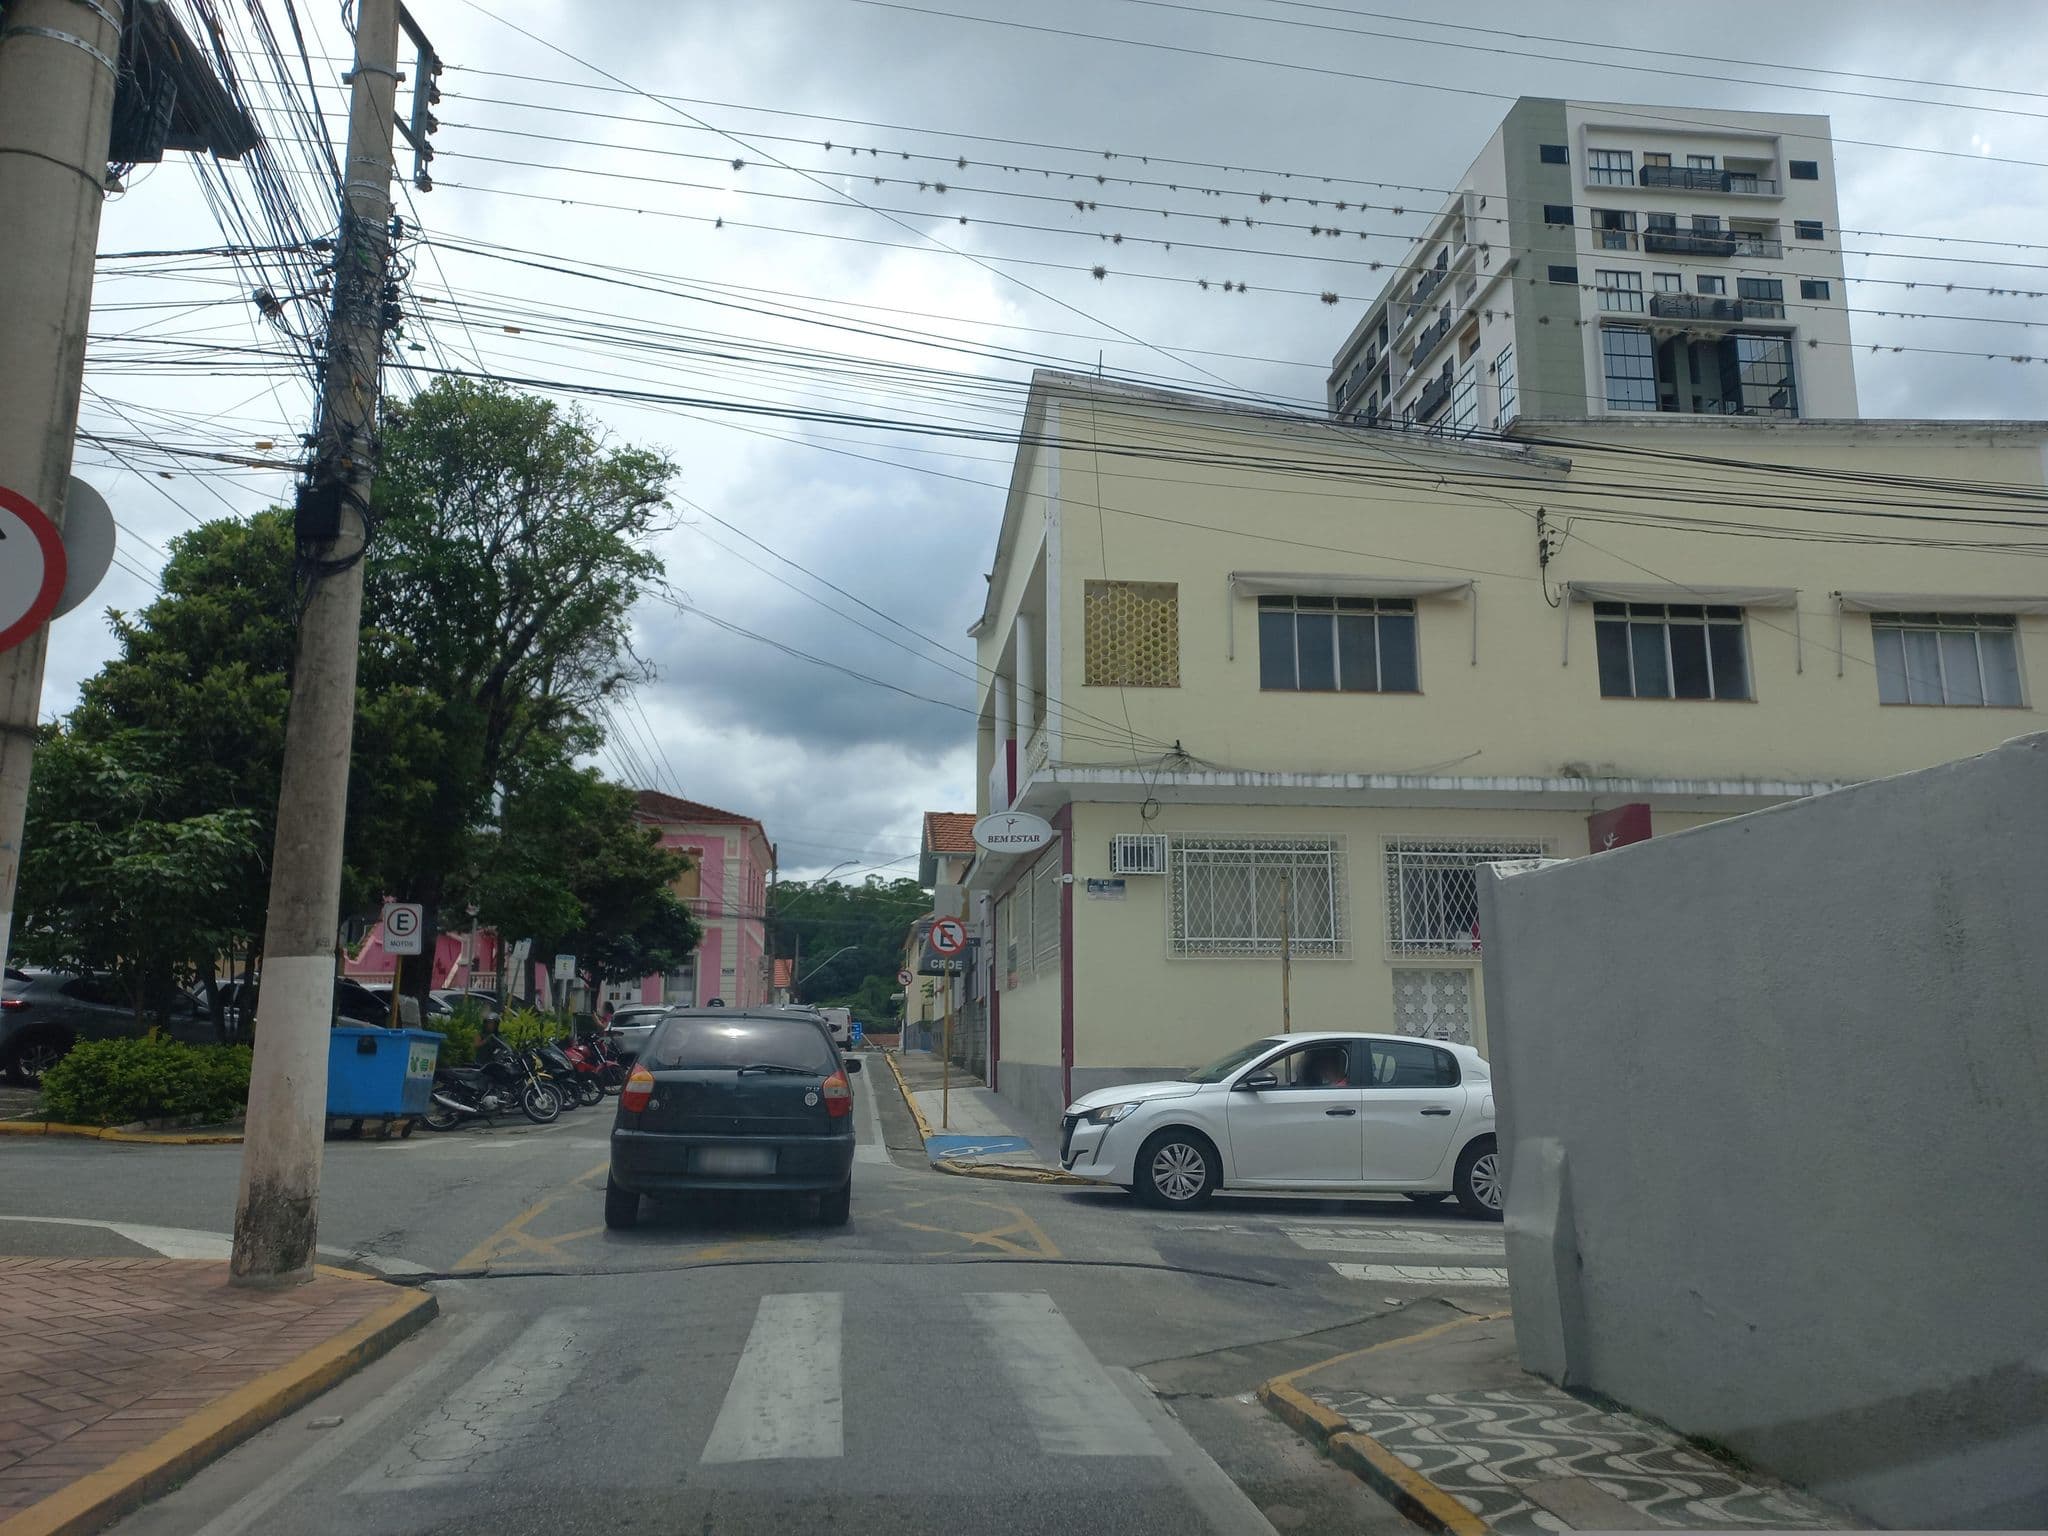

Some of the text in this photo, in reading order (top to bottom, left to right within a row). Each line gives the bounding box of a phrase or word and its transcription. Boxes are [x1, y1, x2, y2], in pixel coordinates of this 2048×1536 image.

[988, 835, 1040, 843] BEM ESTAR
[397, 913, 409, 930] E
[940, 924, 955, 947] E
